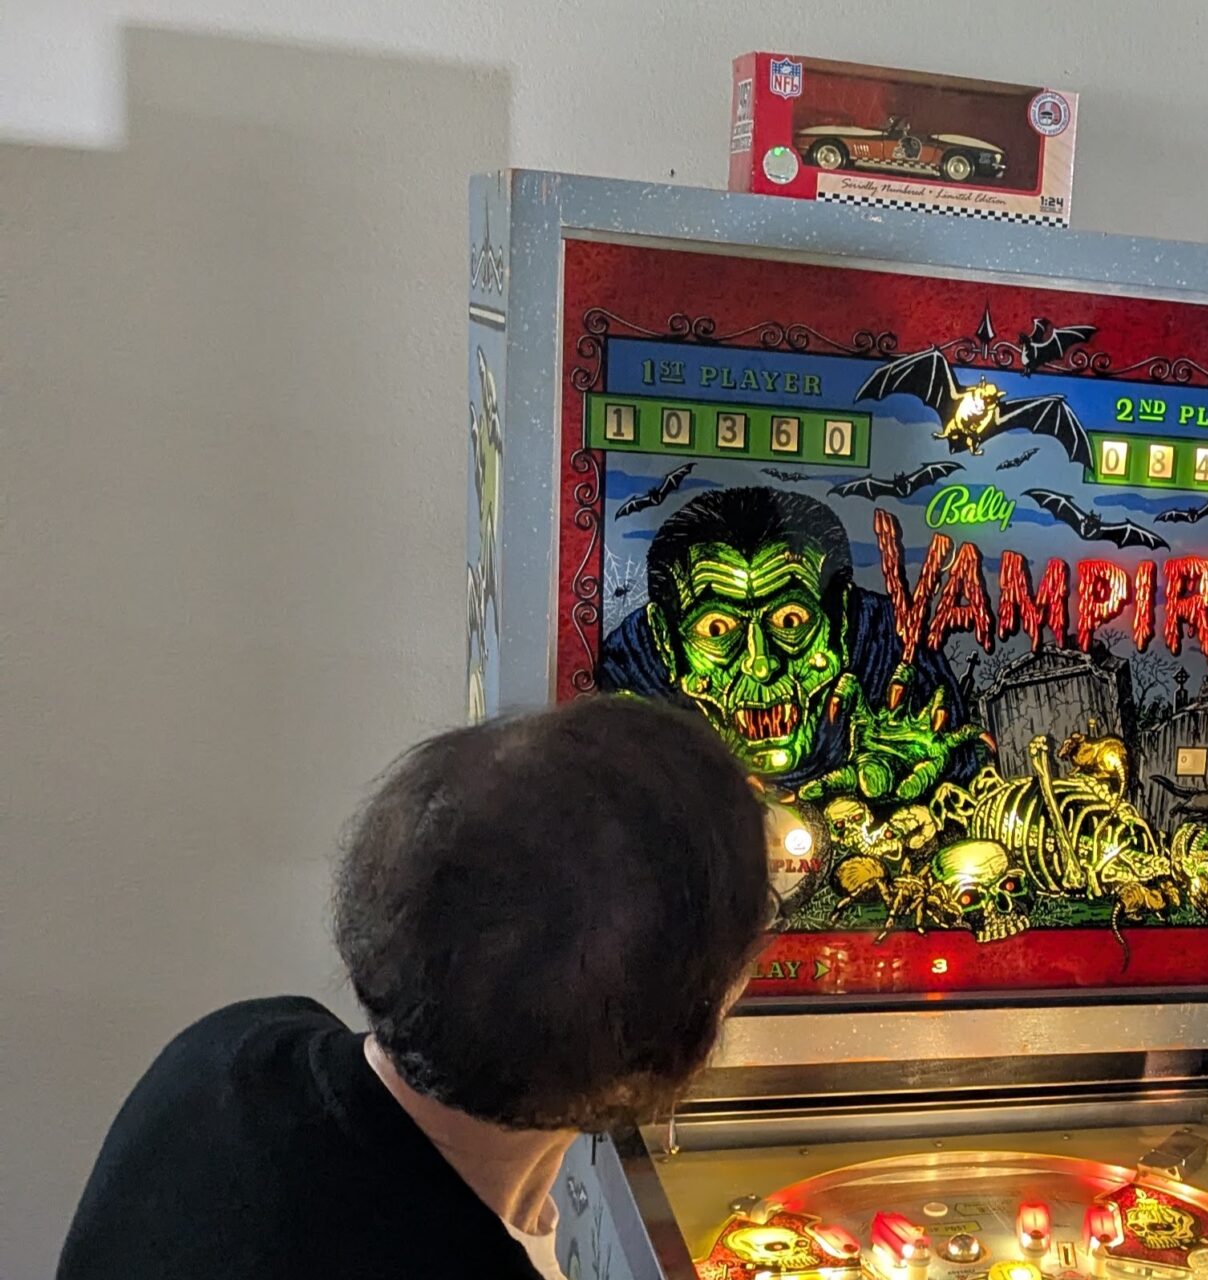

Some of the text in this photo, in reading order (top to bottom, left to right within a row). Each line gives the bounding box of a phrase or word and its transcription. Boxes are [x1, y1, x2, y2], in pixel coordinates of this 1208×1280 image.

[772, 74, 800, 92] NFL
[936, 188, 973, 202] Limited
[974, 193, 1007, 206] Edition
[1040, 195, 1064, 208] 1:24
[641, 358, 823, 396] 1ST PLAYER
[1116, 397, 1166, 422] 2ND
[925, 484, 1017, 532] Bally
[931, 958, 949, 974] 3
